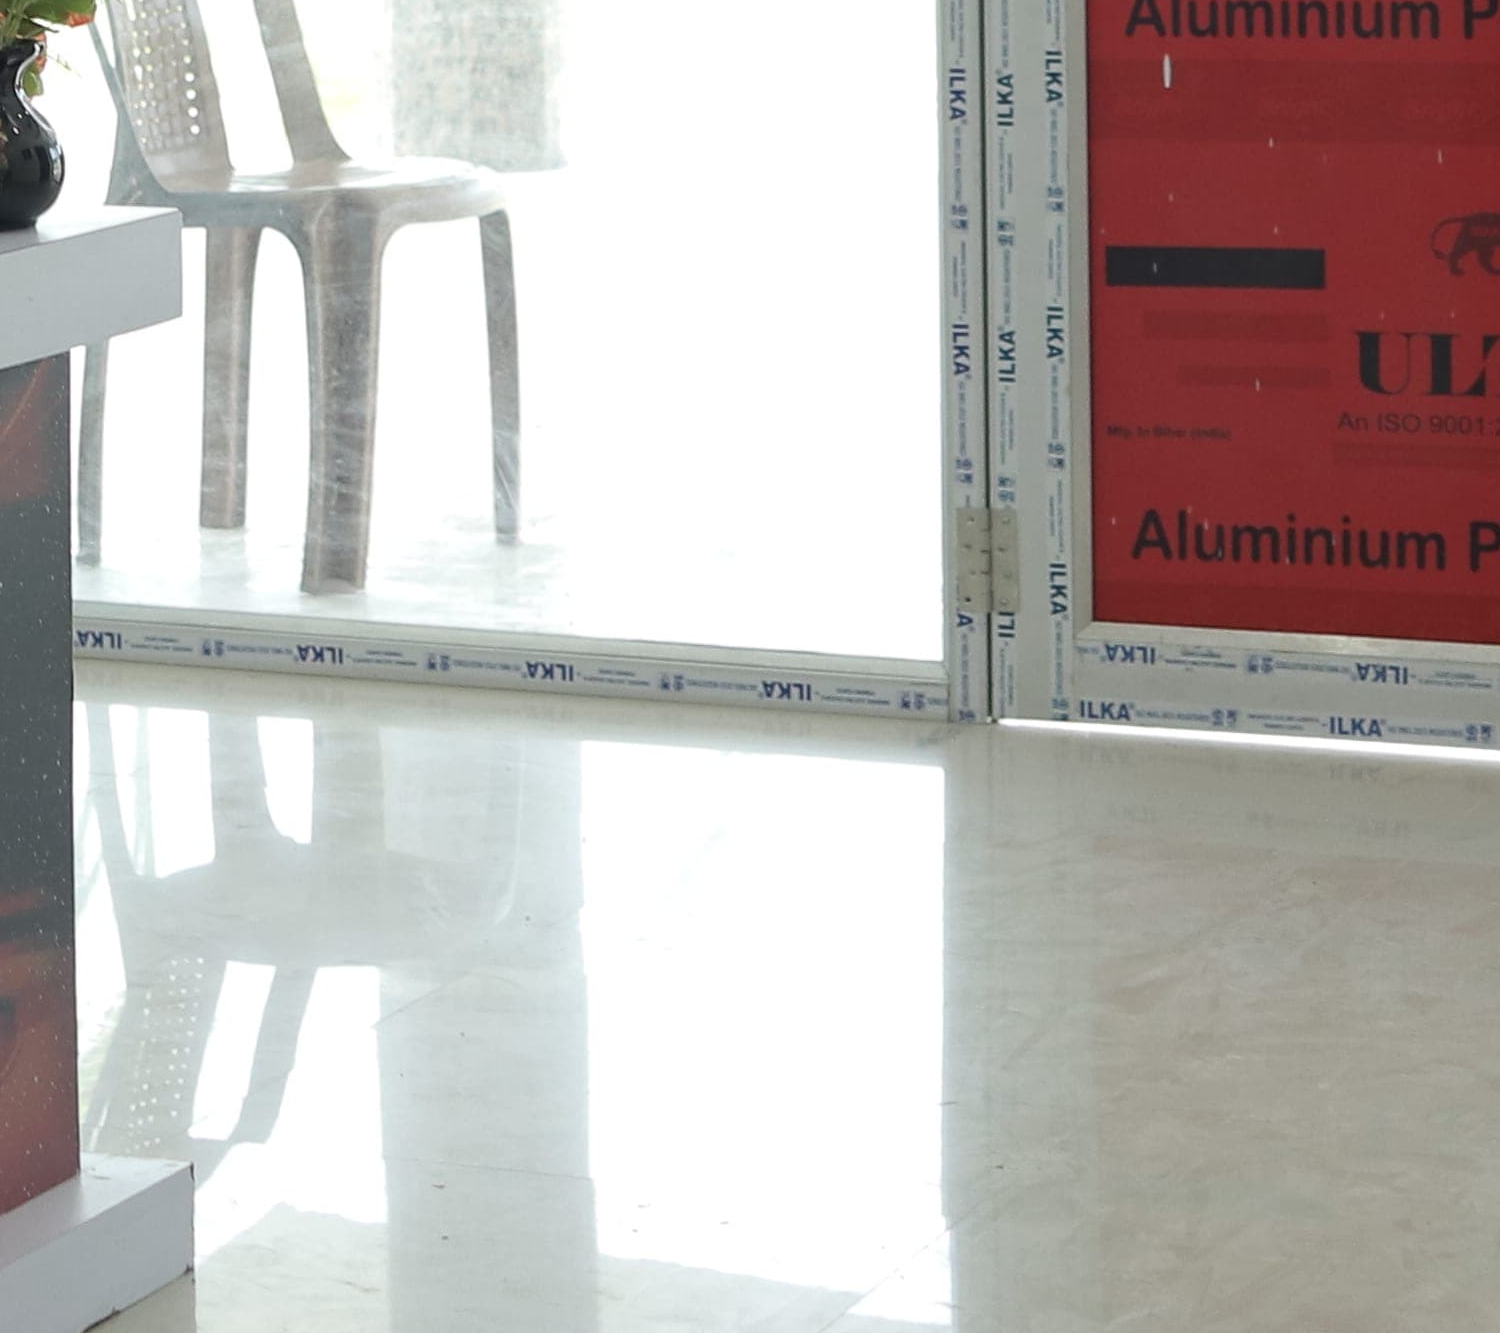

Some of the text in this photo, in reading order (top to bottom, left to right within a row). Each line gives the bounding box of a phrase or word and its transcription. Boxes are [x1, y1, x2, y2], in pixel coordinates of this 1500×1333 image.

[1046, 51, 1062, 102] ILKA
[950, 69, 966, 120] ILKA
[997, 75, 1013, 126] ILKA
[1047, 307, 1063, 358] ILKA
[952, 324, 970, 375] ILKA
[999, 331, 1015, 382] ILKA
[1337, 411, 1369, 431] An
[1377, 413, 1421, 434] ISO
[1131, 508, 1445, 571] Aluminium
[1050, 564, 1067, 614] ILKA
[75, 630, 121, 649] ILKA
[297, 645, 343, 664] ILKA
[1105, 644, 1155, 664] ILKA
[526, 661, 573, 681] ILKA
[1356, 663, 1408, 685] ILKA
[762, 681, 811, 701] ILKA
[1080, 701, 1130, 721] ILKA
[1330, 717, 1382, 737] ILKA
